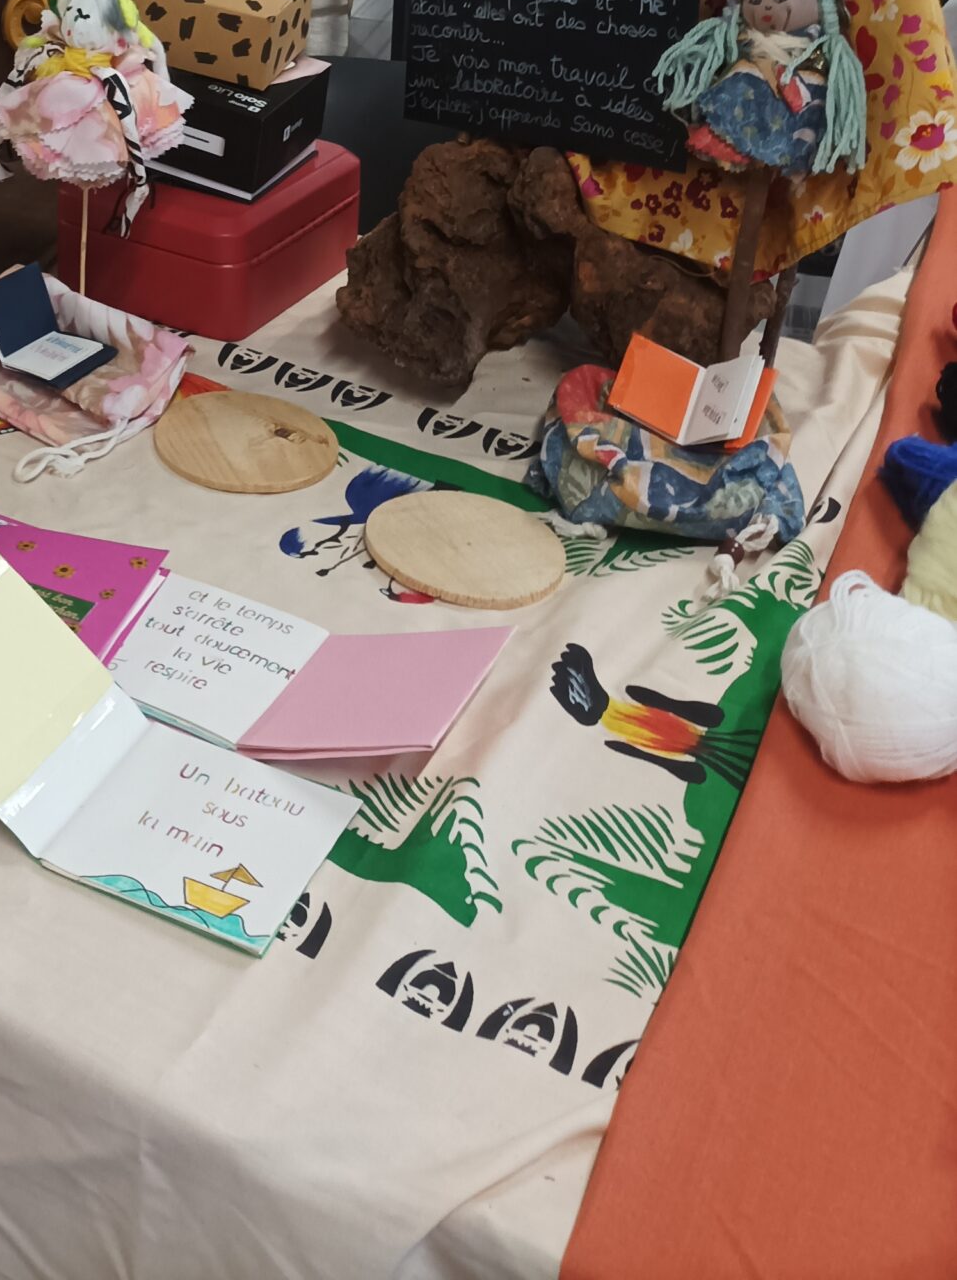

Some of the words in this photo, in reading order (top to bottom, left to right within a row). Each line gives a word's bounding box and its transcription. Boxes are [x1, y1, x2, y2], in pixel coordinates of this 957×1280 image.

[473, 0, 506, 21] elles
[512, 11, 545, 28] ont
[555, 10, 587, 31] des
[596, 15, 658, 38] choses
[411, 44, 441, 63] Je
[452, 48, 491, 70] vois
[498, 58, 542, 75] mon
[550, 55, 636, 89] travail
[234, 91, 268, 109] Solo
[144, 616, 187, 638] tout
[172, 604, 245, 637] s'arrête
[188, 589, 210, 604] et
[212, 596, 232, 612] le
[236, 604, 295, 636] temps
[144, 659, 209, 691] respire
[172, 646, 193, 662] la
[201, 655, 233, 675] vie
[178, 762, 211, 787] Un
[201, 800, 249, 829] sous
